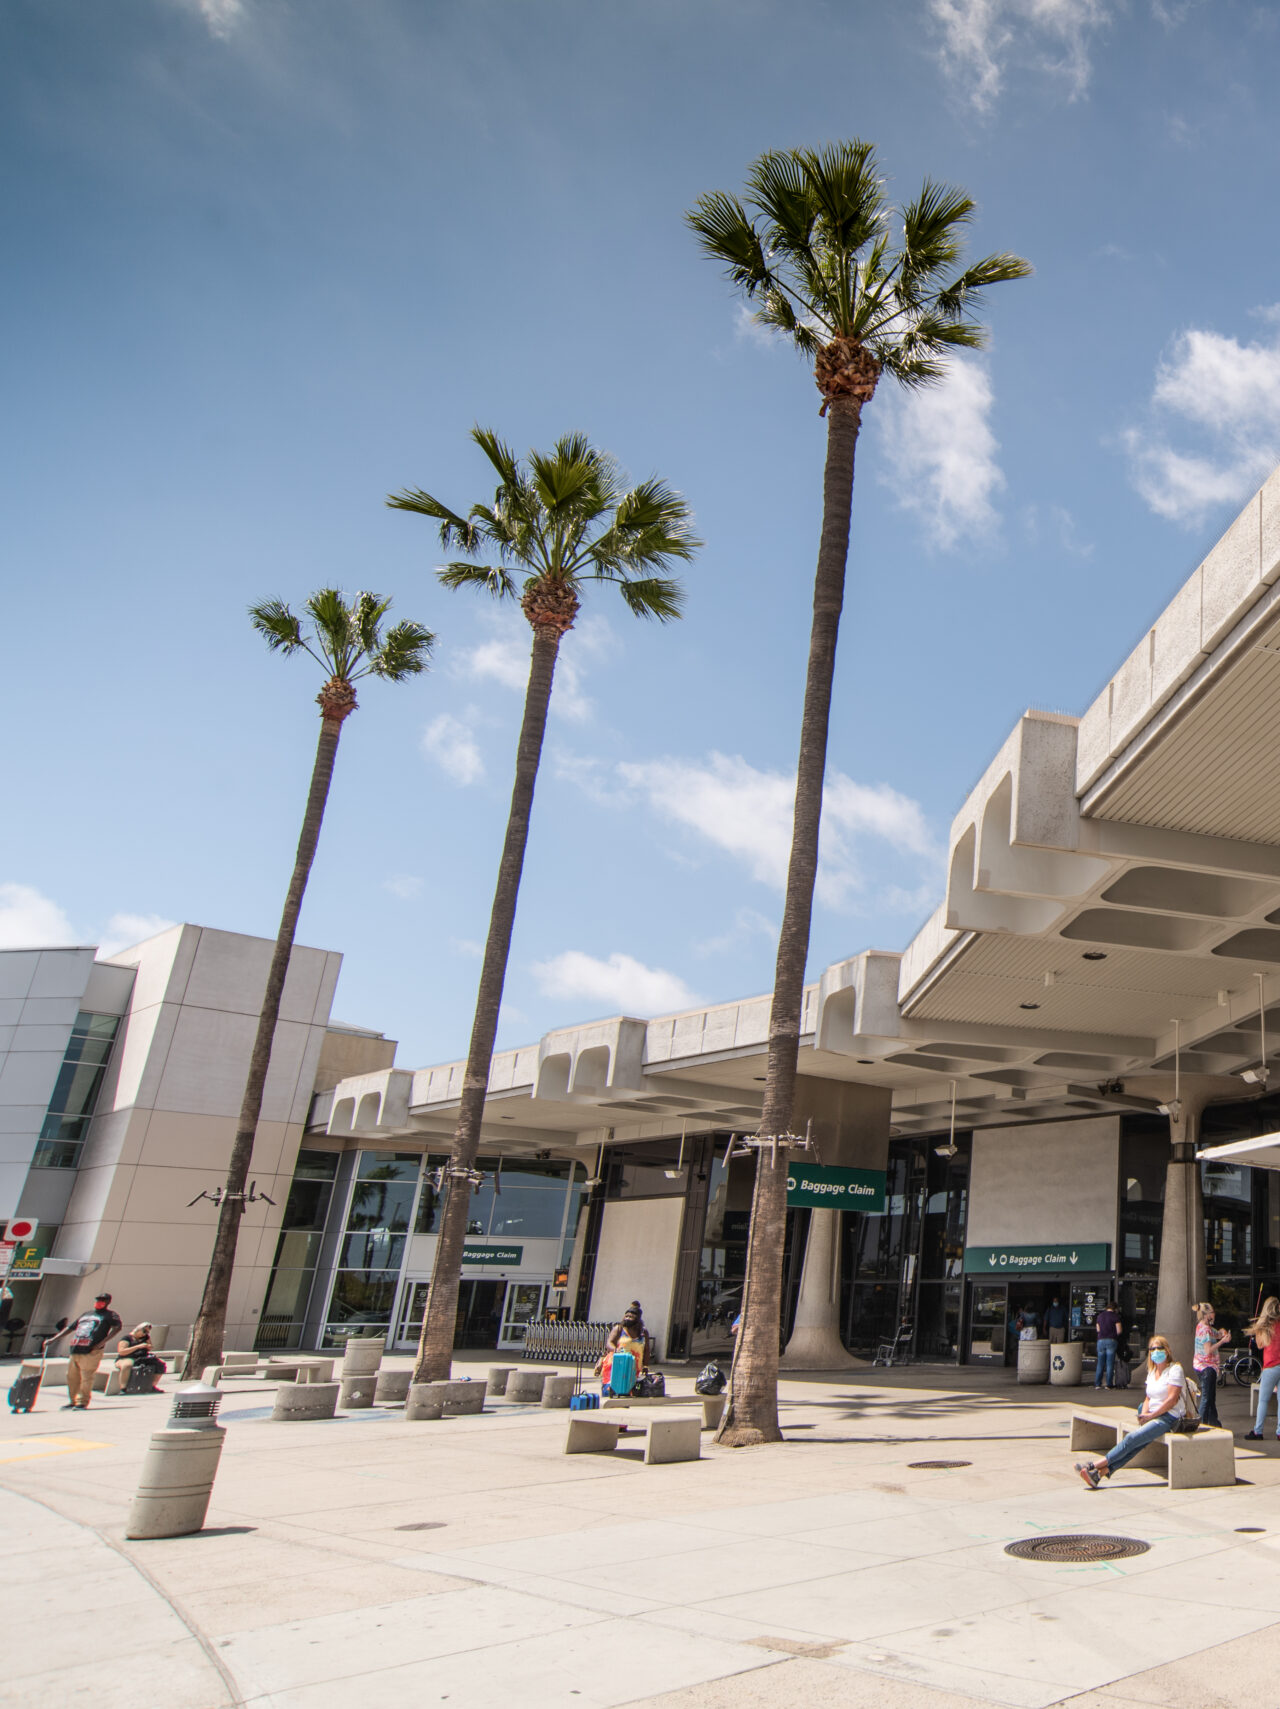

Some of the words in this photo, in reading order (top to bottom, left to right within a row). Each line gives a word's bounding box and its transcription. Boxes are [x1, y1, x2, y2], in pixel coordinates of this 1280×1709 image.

[800, 1180, 846, 1195] Baggage
[848, 1184, 875, 1196] Claim
[24, 1248, 38, 1260] F
[463, 1251, 495, 1259] Baggage
[1009, 1255, 1042, 1266] Baggage
[1044, 1253, 1067, 1264] Claim
[14, 1260, 39, 1269] ZONE
